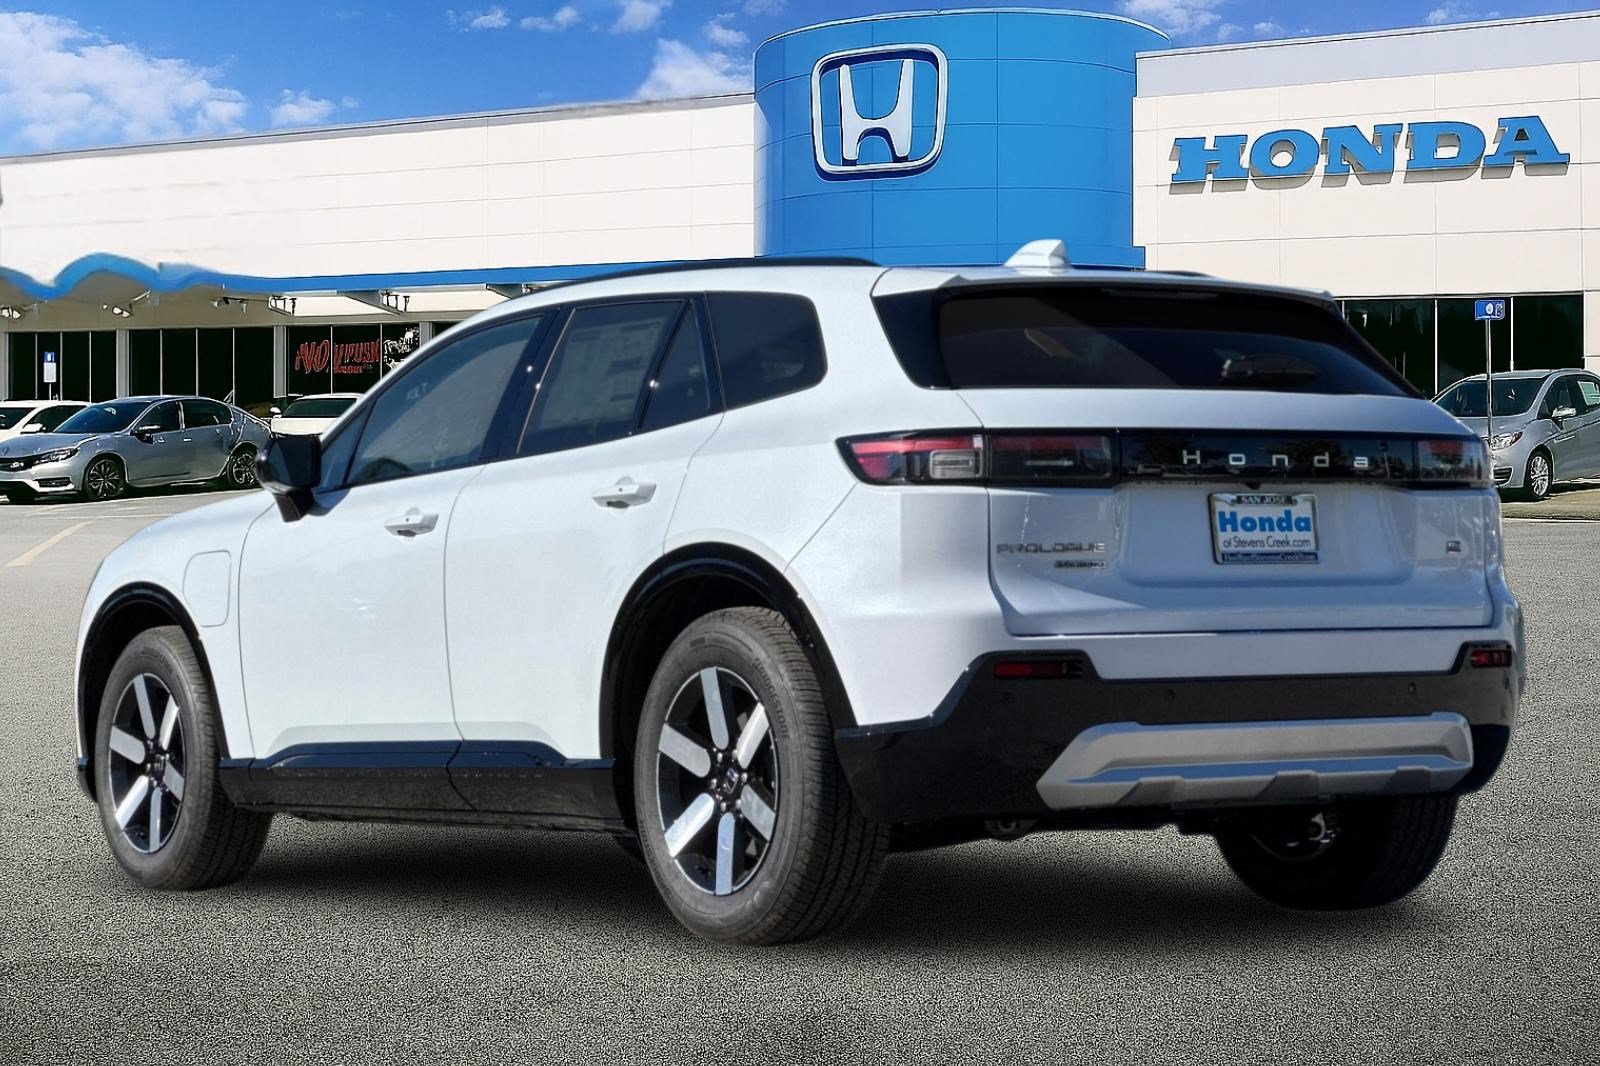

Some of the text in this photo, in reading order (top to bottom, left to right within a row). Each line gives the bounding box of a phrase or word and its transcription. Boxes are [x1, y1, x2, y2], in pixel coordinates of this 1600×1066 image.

[1171, 115, 1571, 184] HONDA
[1182, 449, 1369, 468] Honda
[1241, 495, 1286, 504] SAN JOSE
[1218, 509, 1312, 533] Honda
[996, 542, 1105, 554] PROLOGUE
[1223, 537, 1232, 548] of
[1233, 536, 1266, 548] Stevens
[751, 657, 791, 738] BRIDGESTONE
